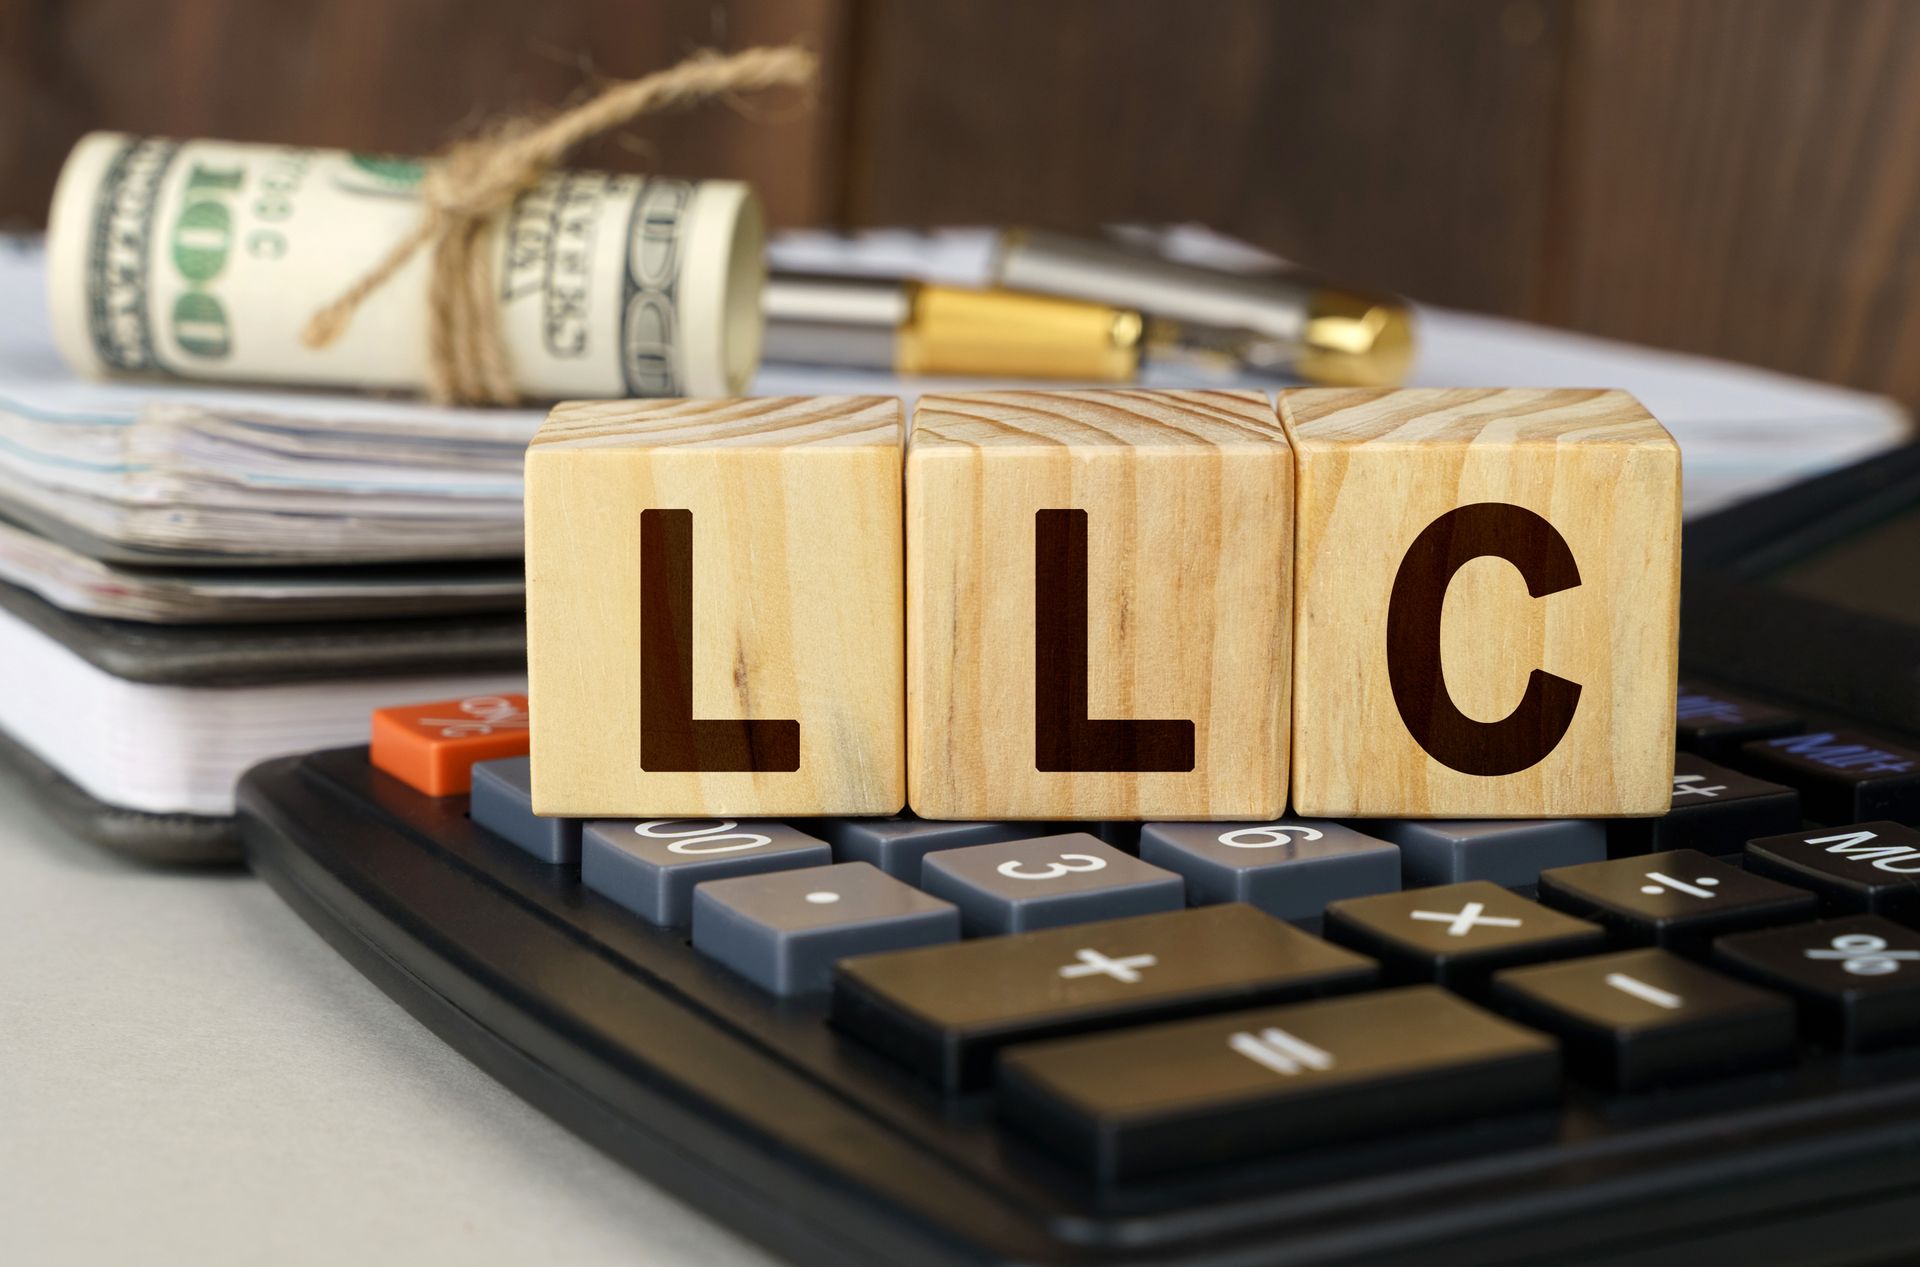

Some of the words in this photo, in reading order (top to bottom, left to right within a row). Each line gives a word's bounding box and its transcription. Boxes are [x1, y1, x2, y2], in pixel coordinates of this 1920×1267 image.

[170, 161, 246, 360] 100
[640, 508, 1583, 777] LLC
[1218, 825, 1324, 849] 6
[1803, 830, 1920, 874] MU
[997, 854, 1108, 880] 3
[1804, 934, 1920, 976] %
